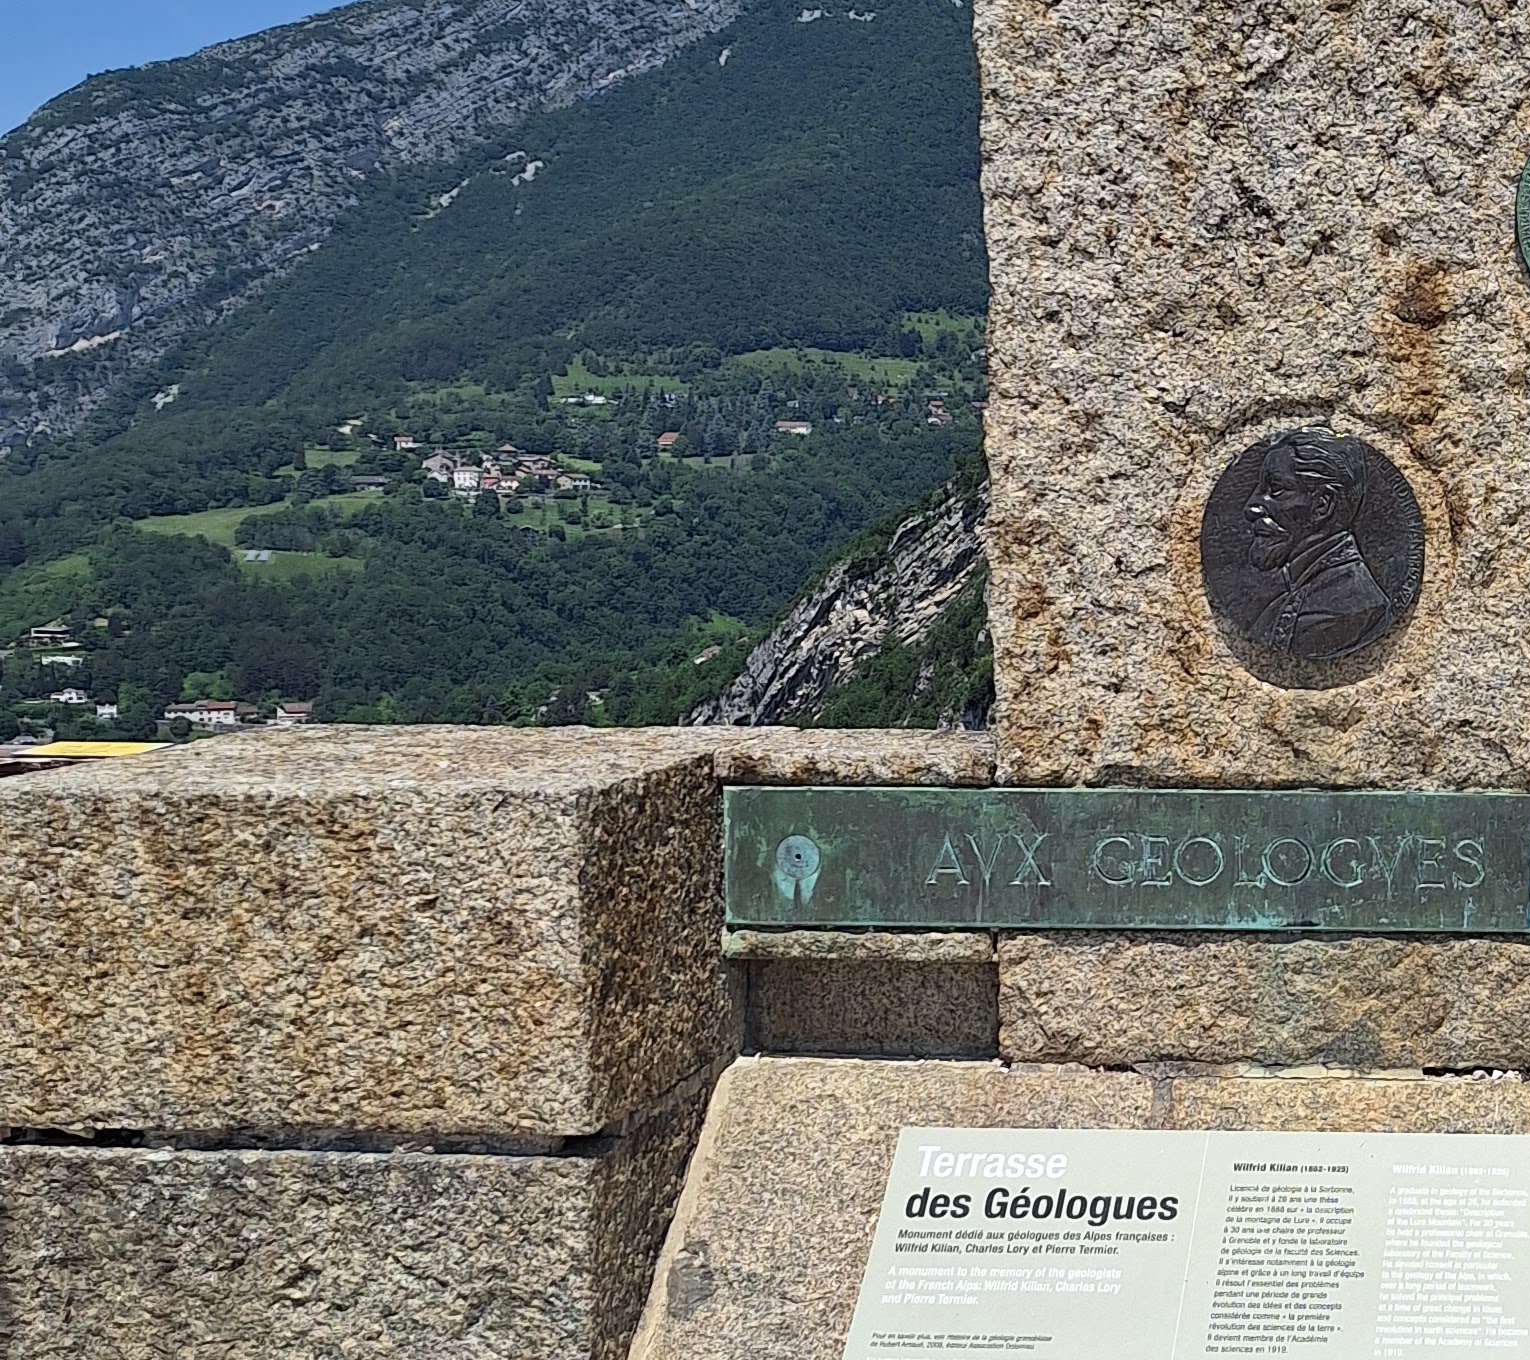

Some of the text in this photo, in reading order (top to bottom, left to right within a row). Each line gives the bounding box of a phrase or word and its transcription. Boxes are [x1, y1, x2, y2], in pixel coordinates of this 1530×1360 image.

[917, 1144, 1069, 1180] Terrasse
[1233, 1162, 1267, 1172] Wilfrid
[1269, 1163, 1298, 1172] Kilian
[905, 1186, 1180, 1228] des Géologues
[897, 1229, 953, 1239] Monument
[954, 1229, 984, 1240] dédié
[985, 1231, 1005, 1240] aux
[1007, 1229, 1060, 1242] géologues
[1062, 1230, 1082, 1241] des
[1082, 1230, 1112, 1242] Alpes
[1115, 1231, 1168, 1243] françaises
[894, 1242, 1121, 1256] Wilfrid Kilian, Charles Lory et Pierre Termier.
[887, 1265, 1122, 1280] A monument to the memory of the geologists
[884, 1278, 1121, 1295] of the French Alps: Wilfrid Kilian, Charles Lory
[880, 1292, 979, 1305] and Pierre Termier.
[1205, 1344, 1219, 1353] des
[1220, 1345, 1254, 1353] sciences
